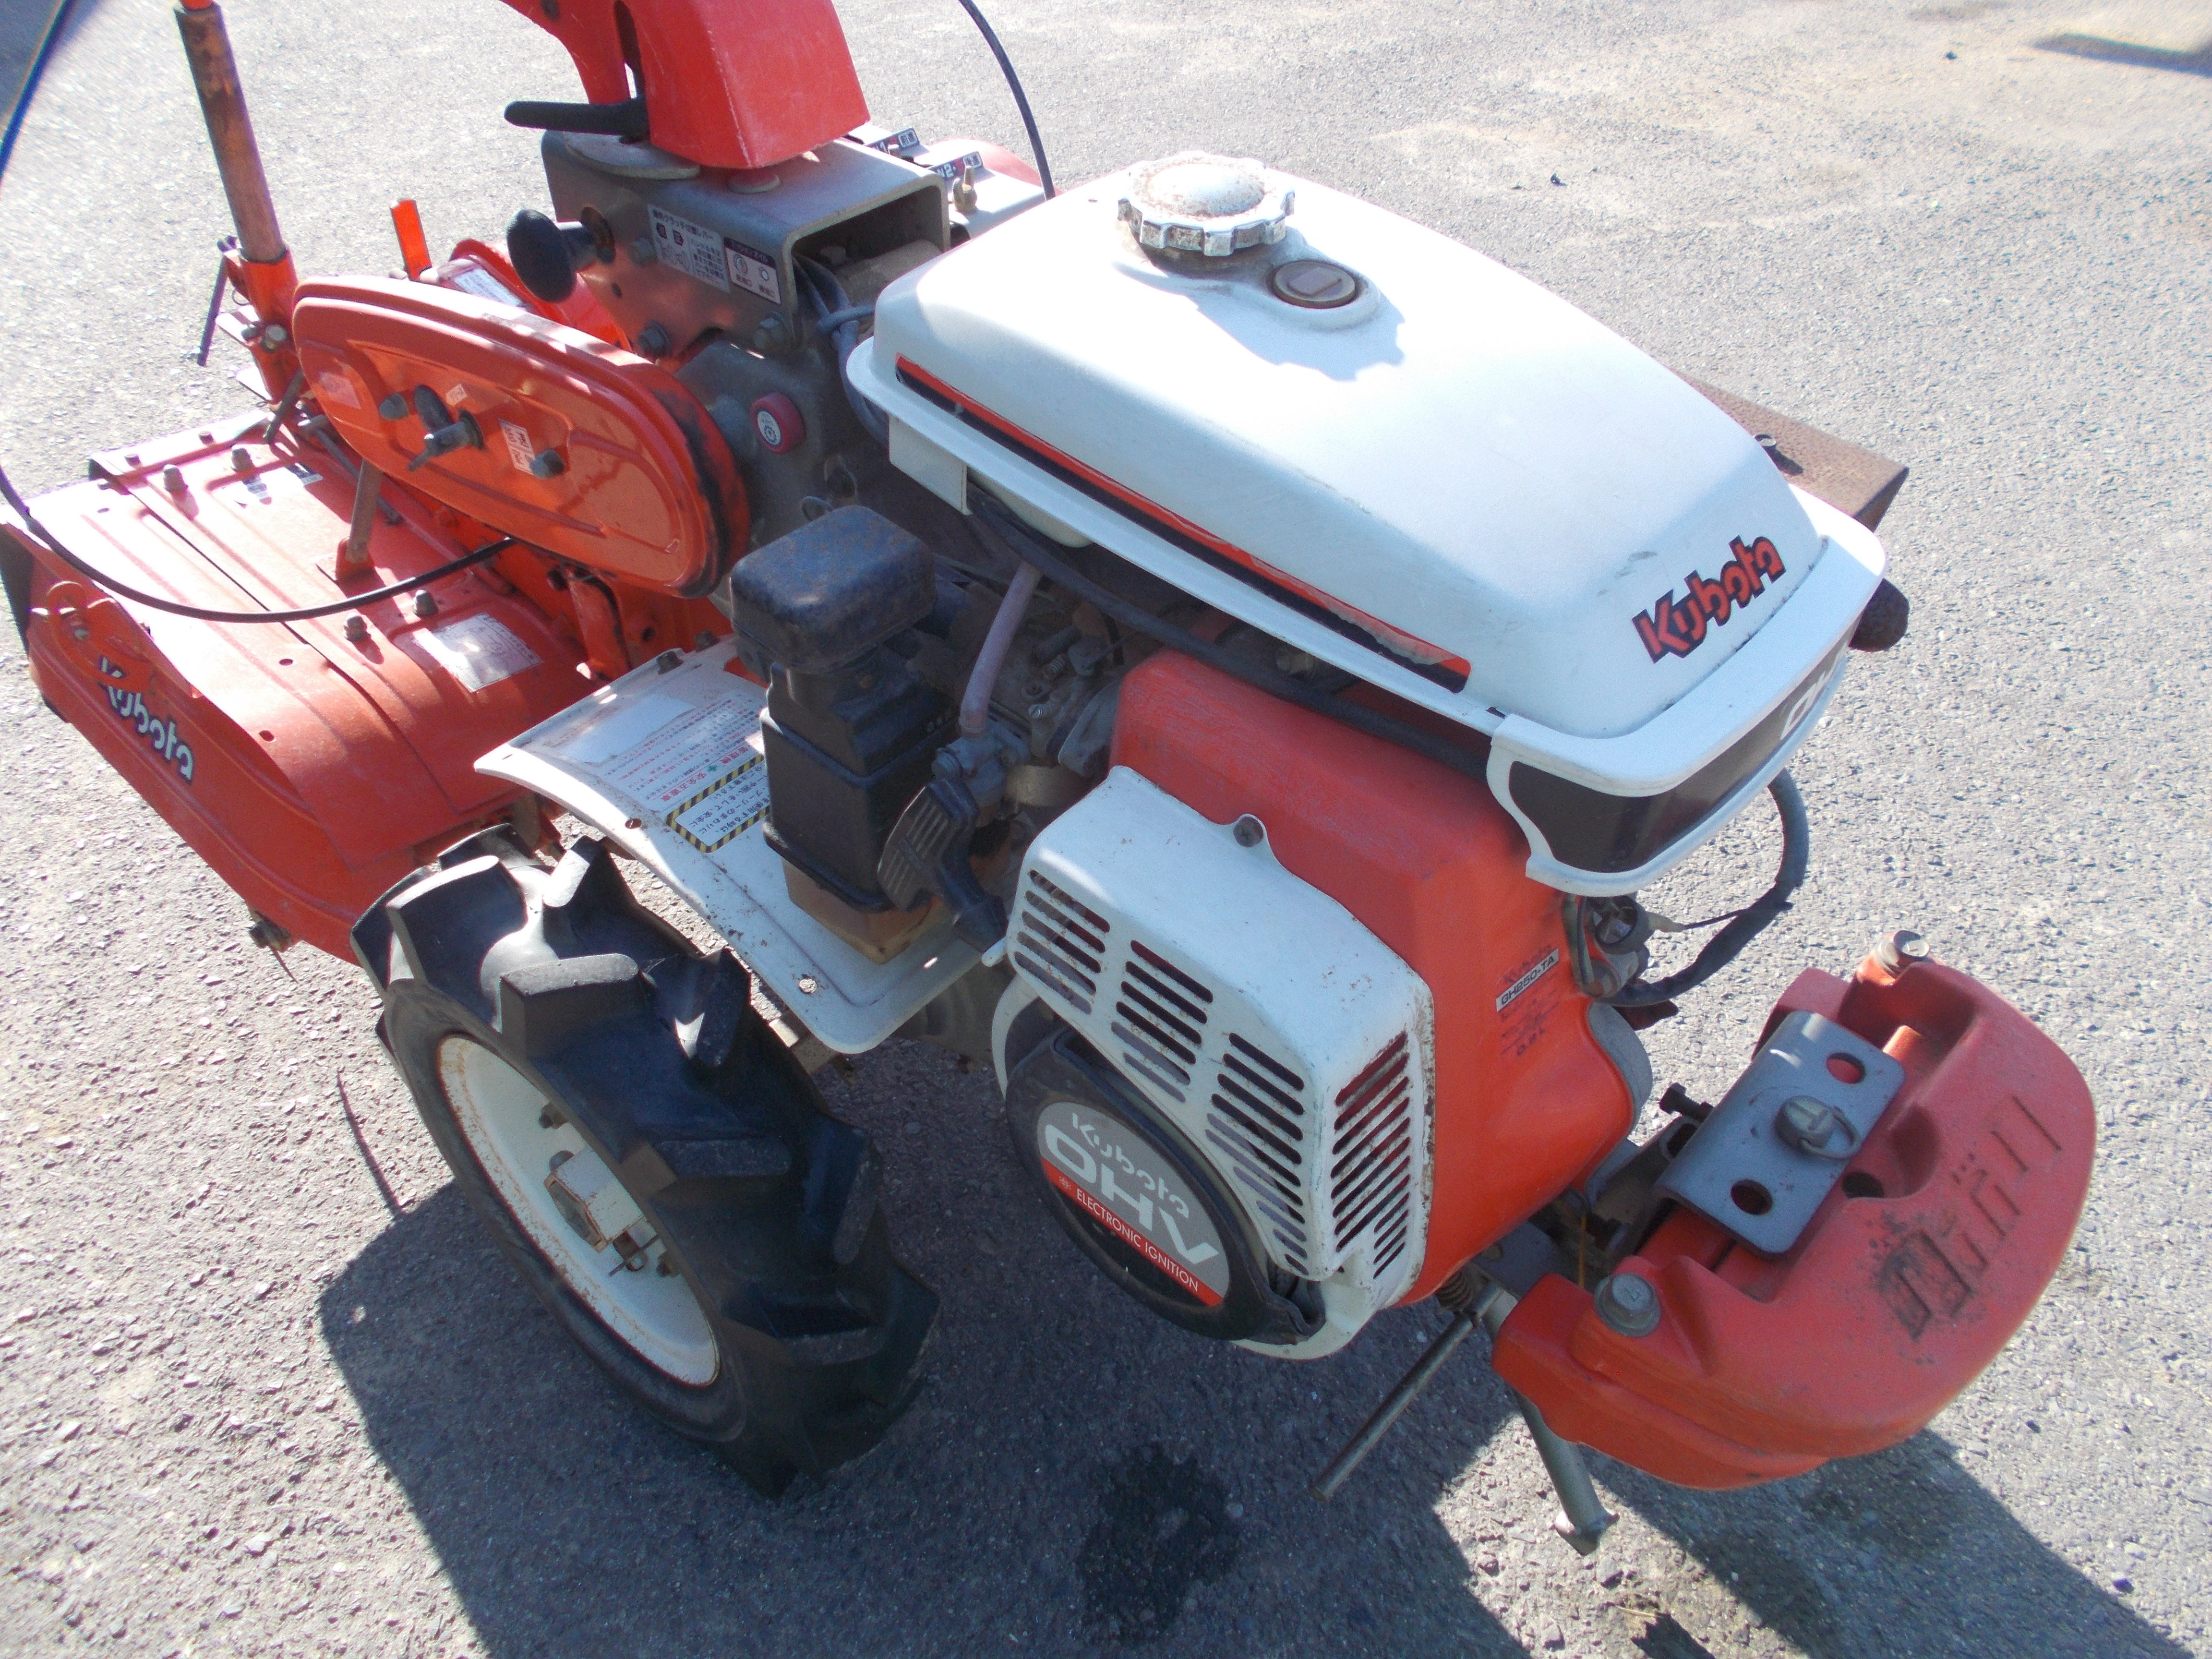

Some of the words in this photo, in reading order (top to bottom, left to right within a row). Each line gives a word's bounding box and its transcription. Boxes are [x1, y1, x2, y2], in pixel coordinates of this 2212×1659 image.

[1632, 535, 1786, 663] Kubota
[98, 656, 194, 784] Kubota
[715, 795, 772, 835] を使用する時は、
[1501, 955, 1555, 1005] GH250-TA
[1045, 1124, 1219, 1265] OHV
[1072, 1111, 1190, 1220] Kubota
[1077, 1188, 1142, 1248] ELECTRONIC
[1144, 1241, 1199, 1292] IGNITION
